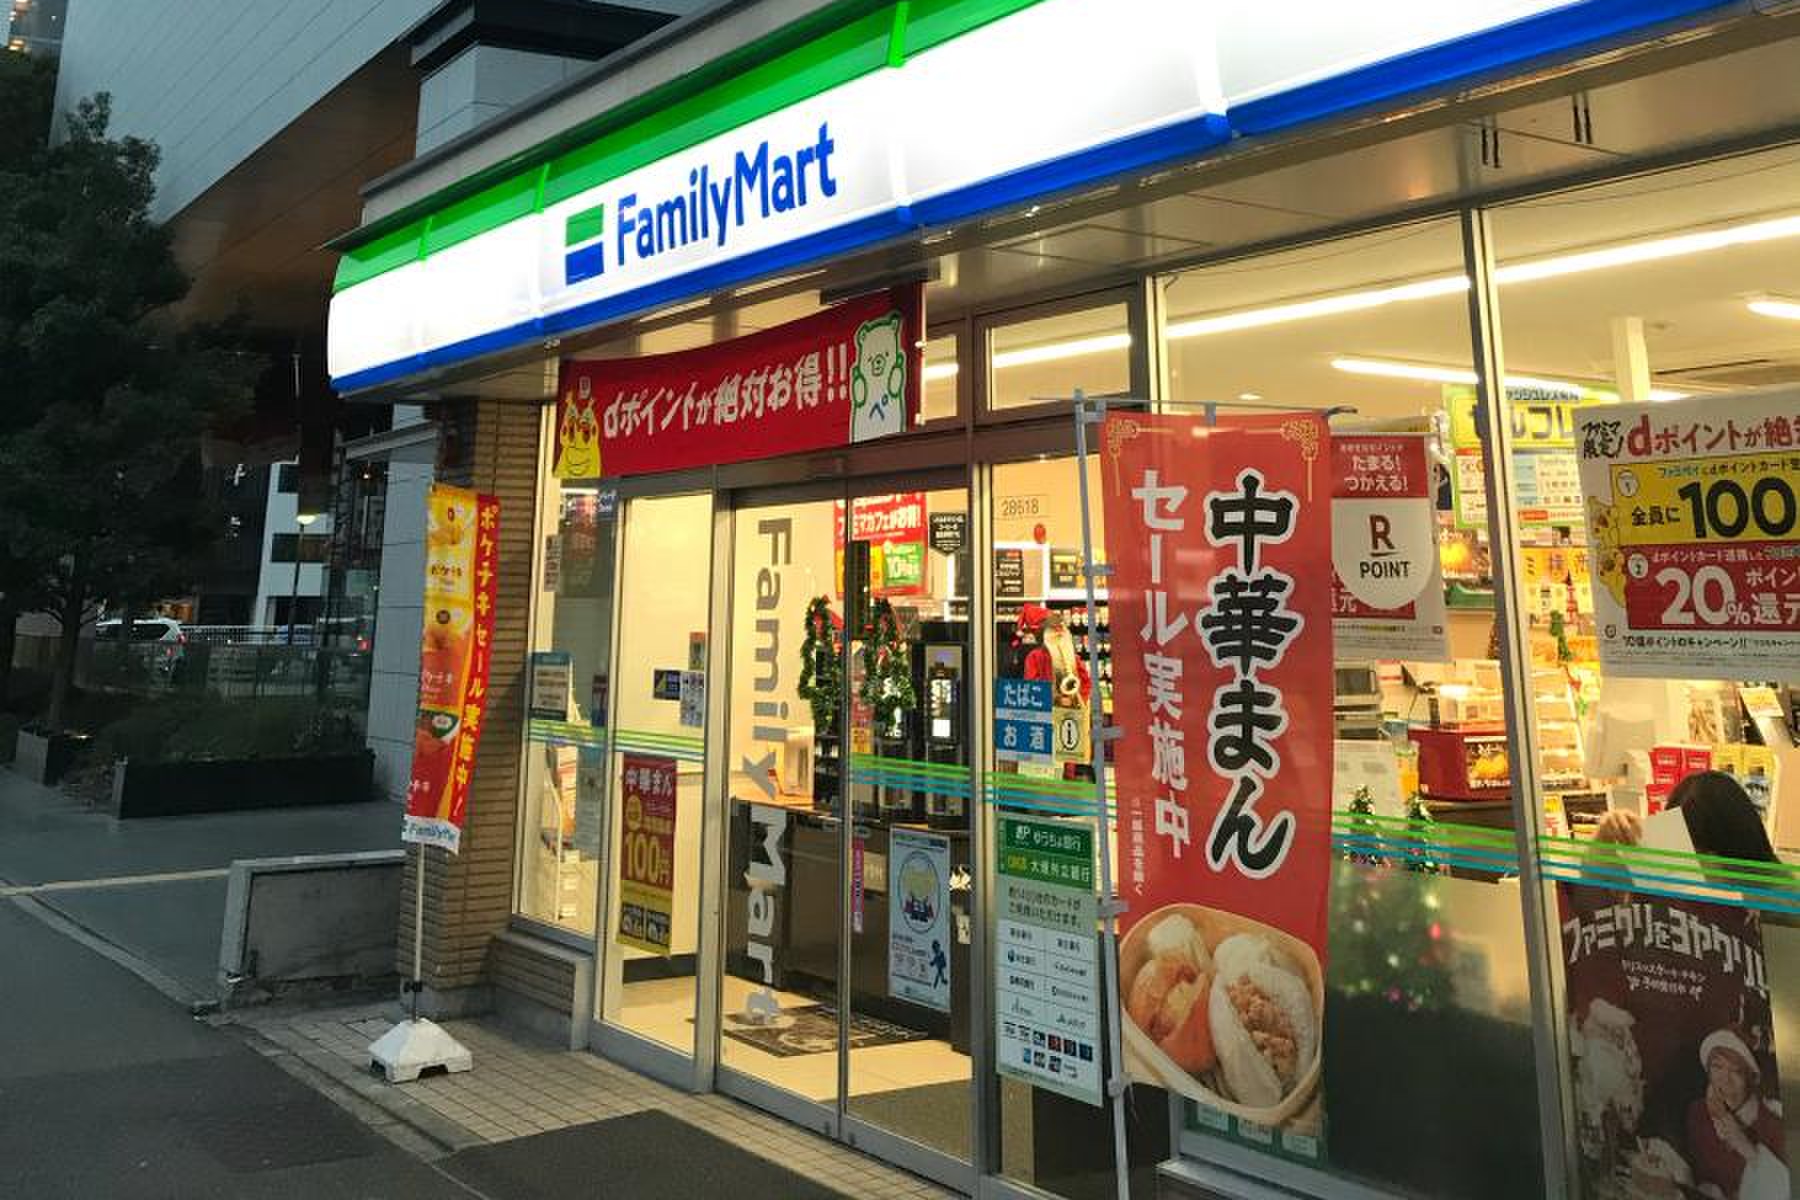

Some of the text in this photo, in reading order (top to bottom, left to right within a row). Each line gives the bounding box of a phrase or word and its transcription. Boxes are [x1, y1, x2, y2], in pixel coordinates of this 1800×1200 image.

[617, 122, 836, 266] FamilyMart
[603, 343, 848, 438] dポイントが絶対お得!!
[1369, 514, 1396, 551] R
[1631, 505, 1681, 527] 全員に
[1678, 477, 1797, 539] 100
[1358, 560, 1412, 580] POINT
[742, 517, 792, 800] Family
[1131, 469, 1191, 859] セール実施中
[1195, 467, 1305, 880] 中華まん
[1003, 682, 1043, 707] たばこ
[1003, 723, 1045, 752] お酒
